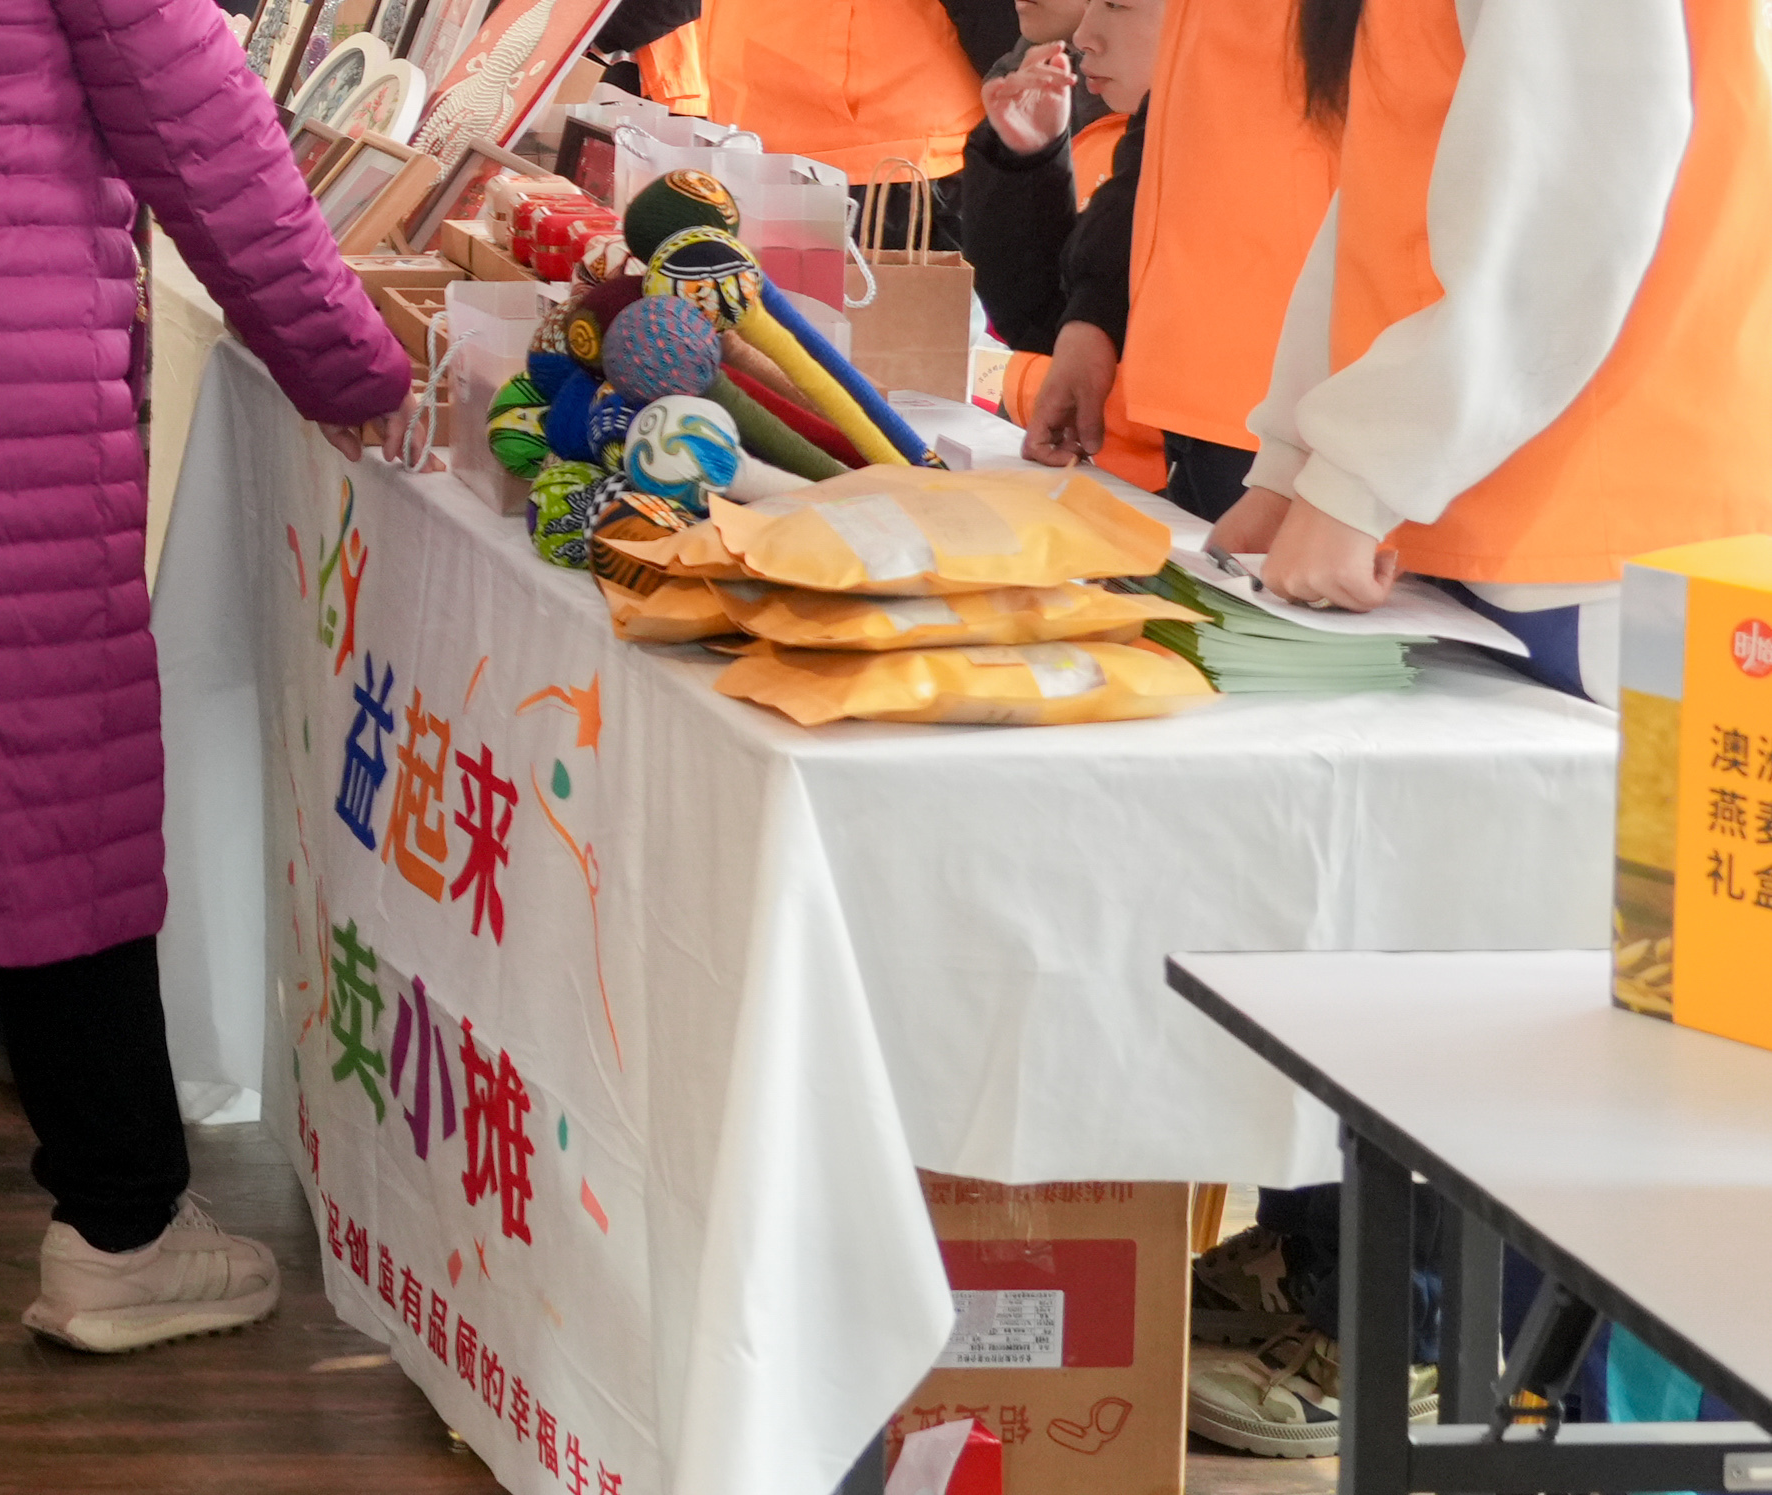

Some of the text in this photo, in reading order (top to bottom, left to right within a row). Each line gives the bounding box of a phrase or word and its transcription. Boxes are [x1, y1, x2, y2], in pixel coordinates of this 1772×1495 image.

[334, 651, 519, 945] 益起来
[329, 917, 534, 1248] 卖小摊
